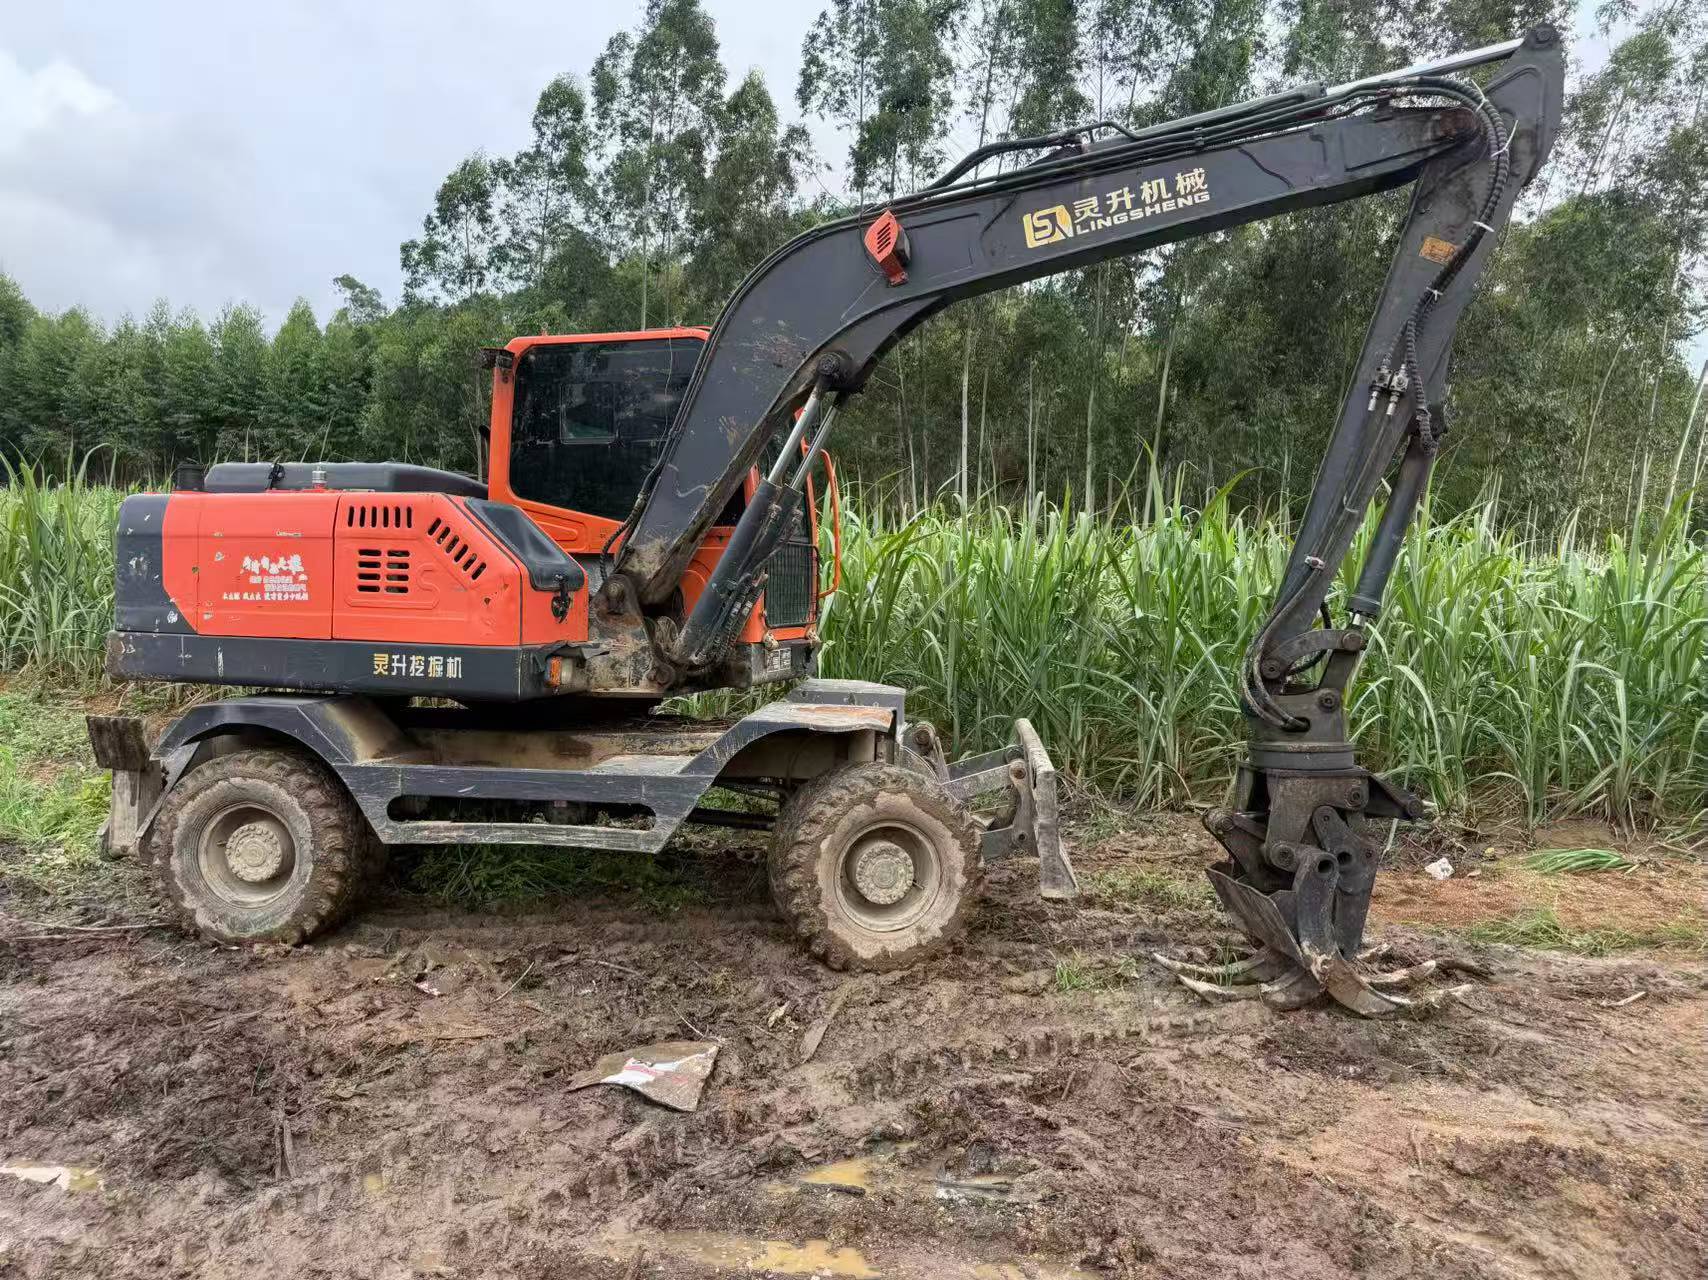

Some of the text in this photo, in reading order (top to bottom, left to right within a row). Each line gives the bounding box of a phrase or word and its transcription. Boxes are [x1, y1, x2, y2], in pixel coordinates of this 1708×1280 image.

[1073, 167, 1208, 223] 灵升机械
[1076, 191, 1210, 236] LINGSHENG
[373, 653, 462, 679] 灵升挖掘机
